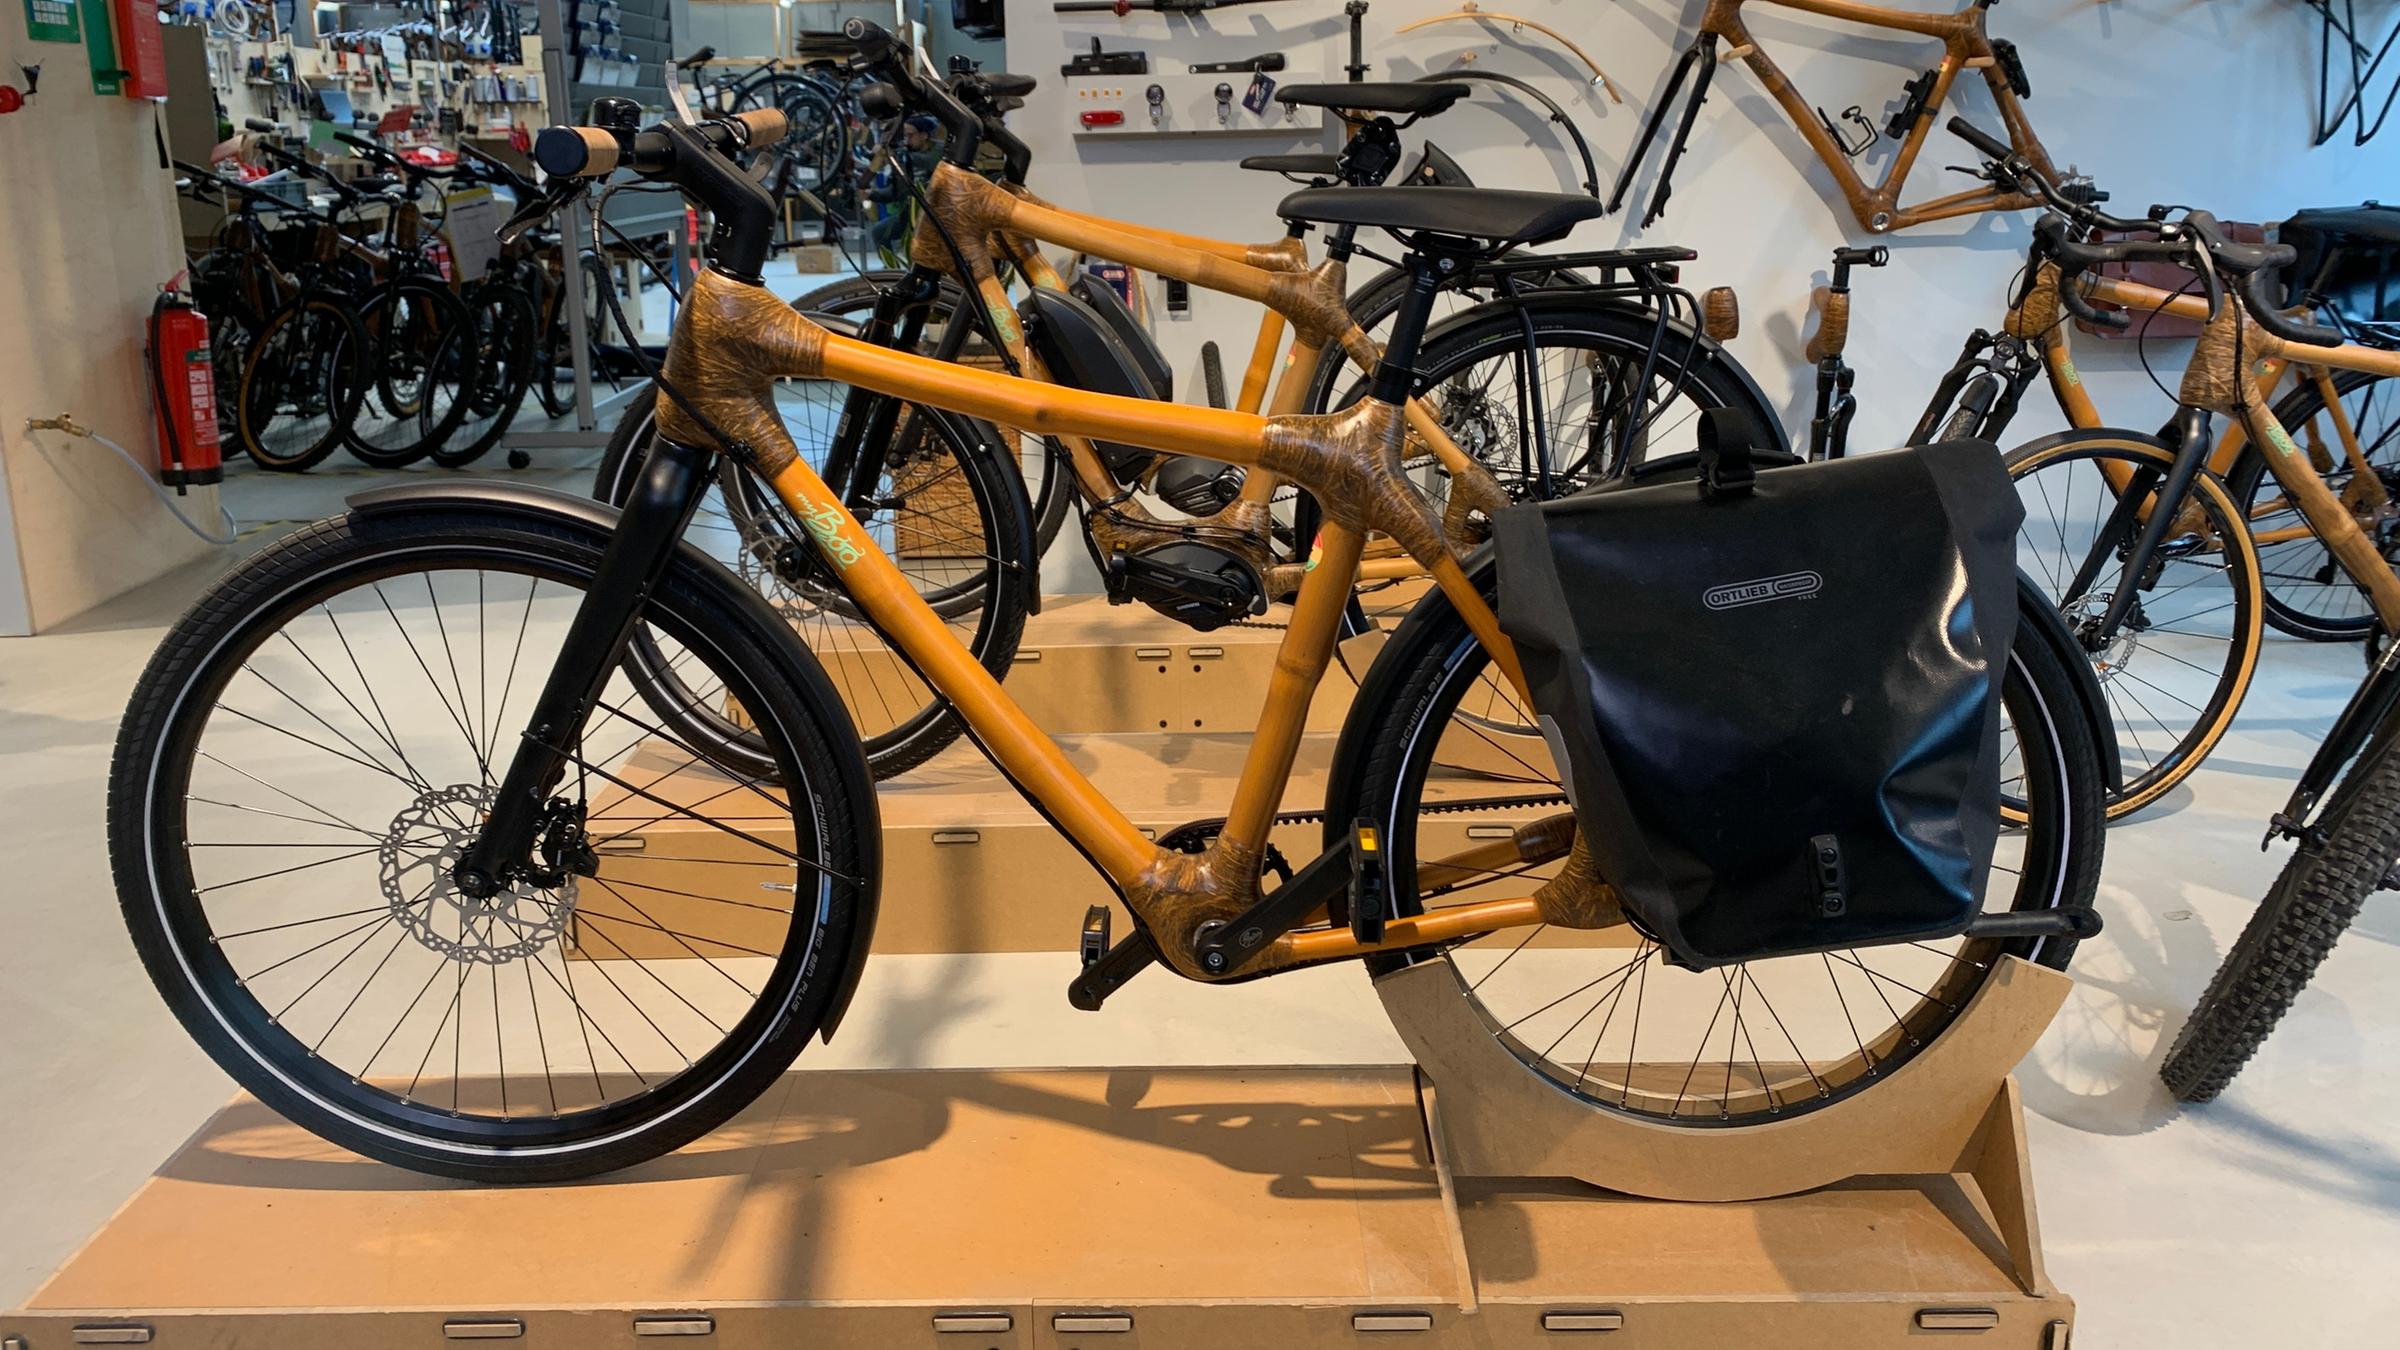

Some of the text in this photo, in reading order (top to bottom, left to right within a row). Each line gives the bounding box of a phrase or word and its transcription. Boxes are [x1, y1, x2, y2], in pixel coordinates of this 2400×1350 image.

[1711, 584, 1769, 603] ORTLIEB
[813, 792, 832, 869] SCHWALBE
[815, 927, 825, 950] BIG
[791, 980, 809, 1012] PLUS
